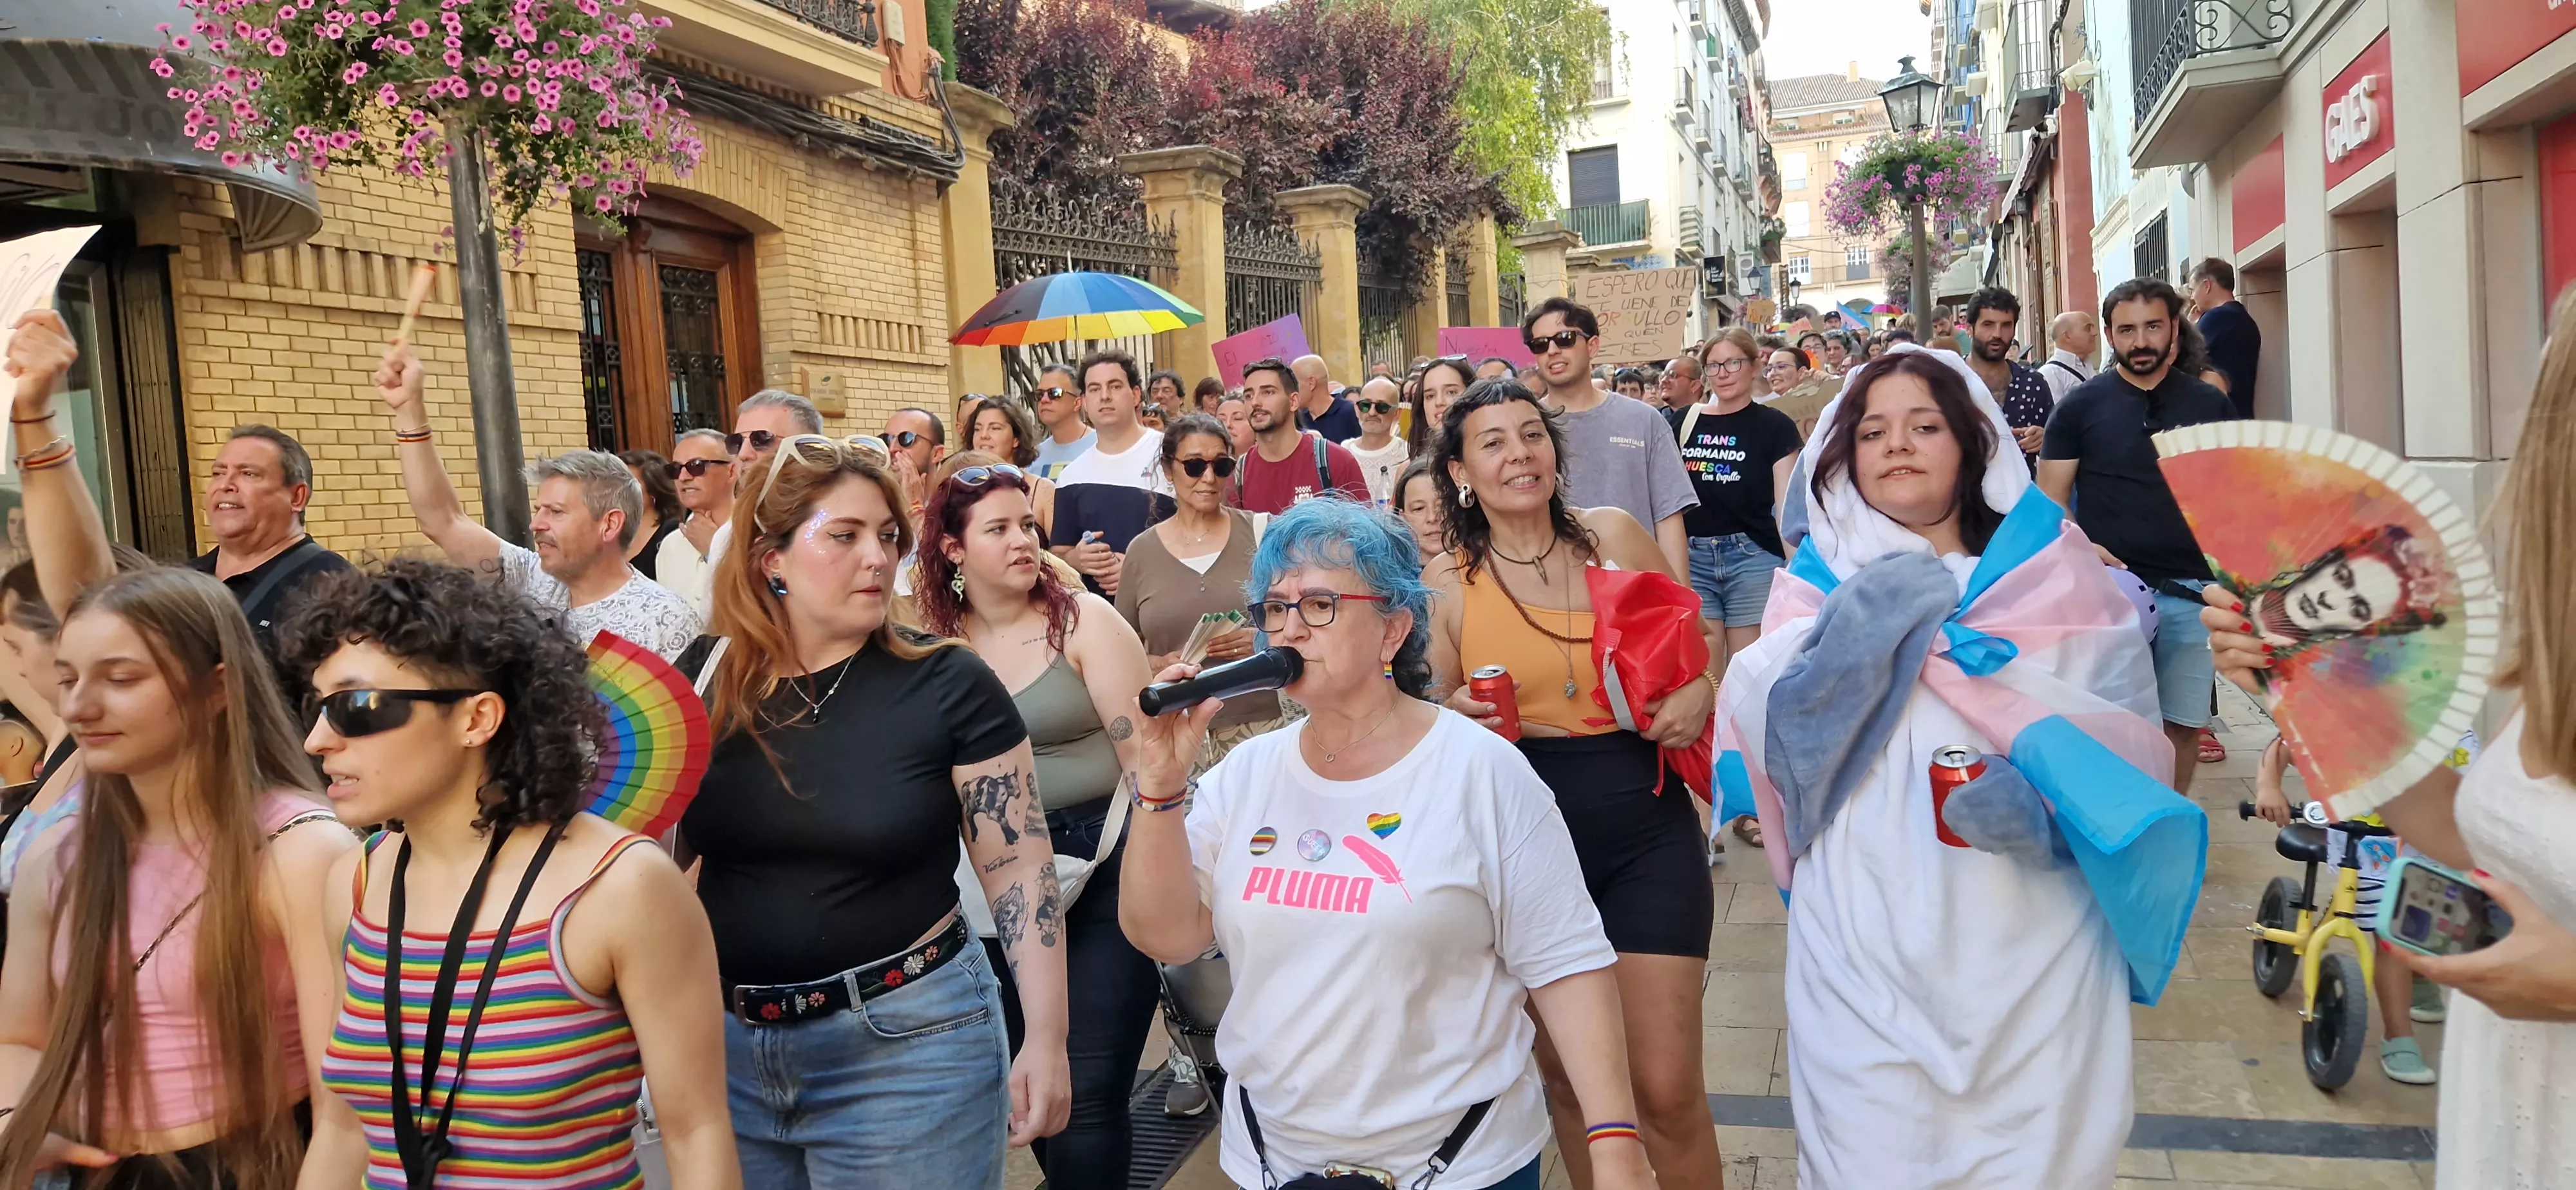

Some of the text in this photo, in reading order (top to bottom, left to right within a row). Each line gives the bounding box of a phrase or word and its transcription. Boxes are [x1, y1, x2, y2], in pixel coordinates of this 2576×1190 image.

[2325, 75, 2380, 164] GAES
[1586, 270, 1658, 298] ESPERO
[1665, 269, 1695, 292] QUE
[1671, 296, 1690, 308] DE
[1597, 310, 1680, 327] ORULLO
[1609, 437, 1644, 447] ESSENTIALS
[1697, 434, 1737, 446] TRANS
[1681, 448, 1746, 462] FORMANDO
[1685, 461, 1731, 474] HUESCA
[1701, 472, 1714, 481] Con
[1303, 834, 1325, 856] QUEER
[1242, 866, 1374, 914] PLUMA
